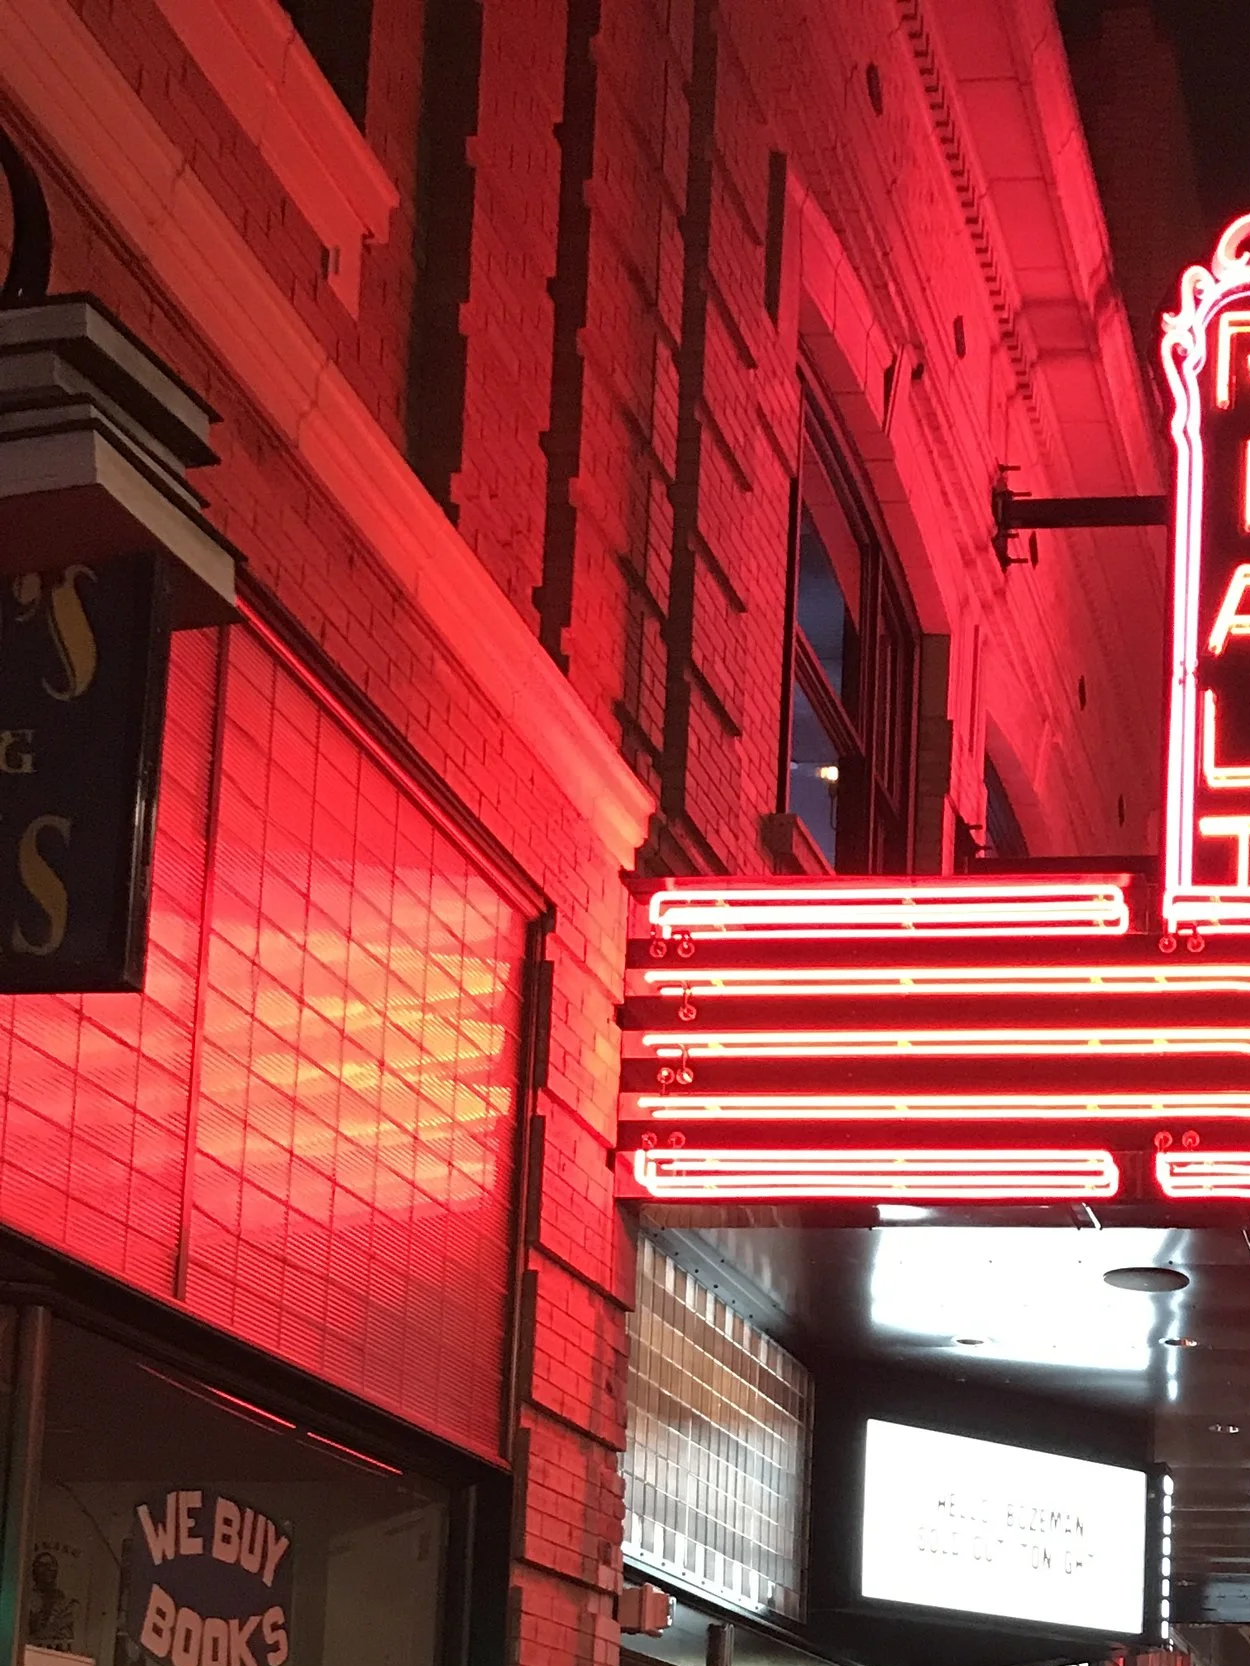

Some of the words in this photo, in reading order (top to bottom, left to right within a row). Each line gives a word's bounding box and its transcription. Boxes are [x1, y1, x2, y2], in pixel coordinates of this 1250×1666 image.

[936, 1491, 990, 1525] HEO
[136, 1490, 205, 1566] WE
[211, 1495, 291, 1588] BUY
[1018, 1542, 1097, 1576] TONGHT
